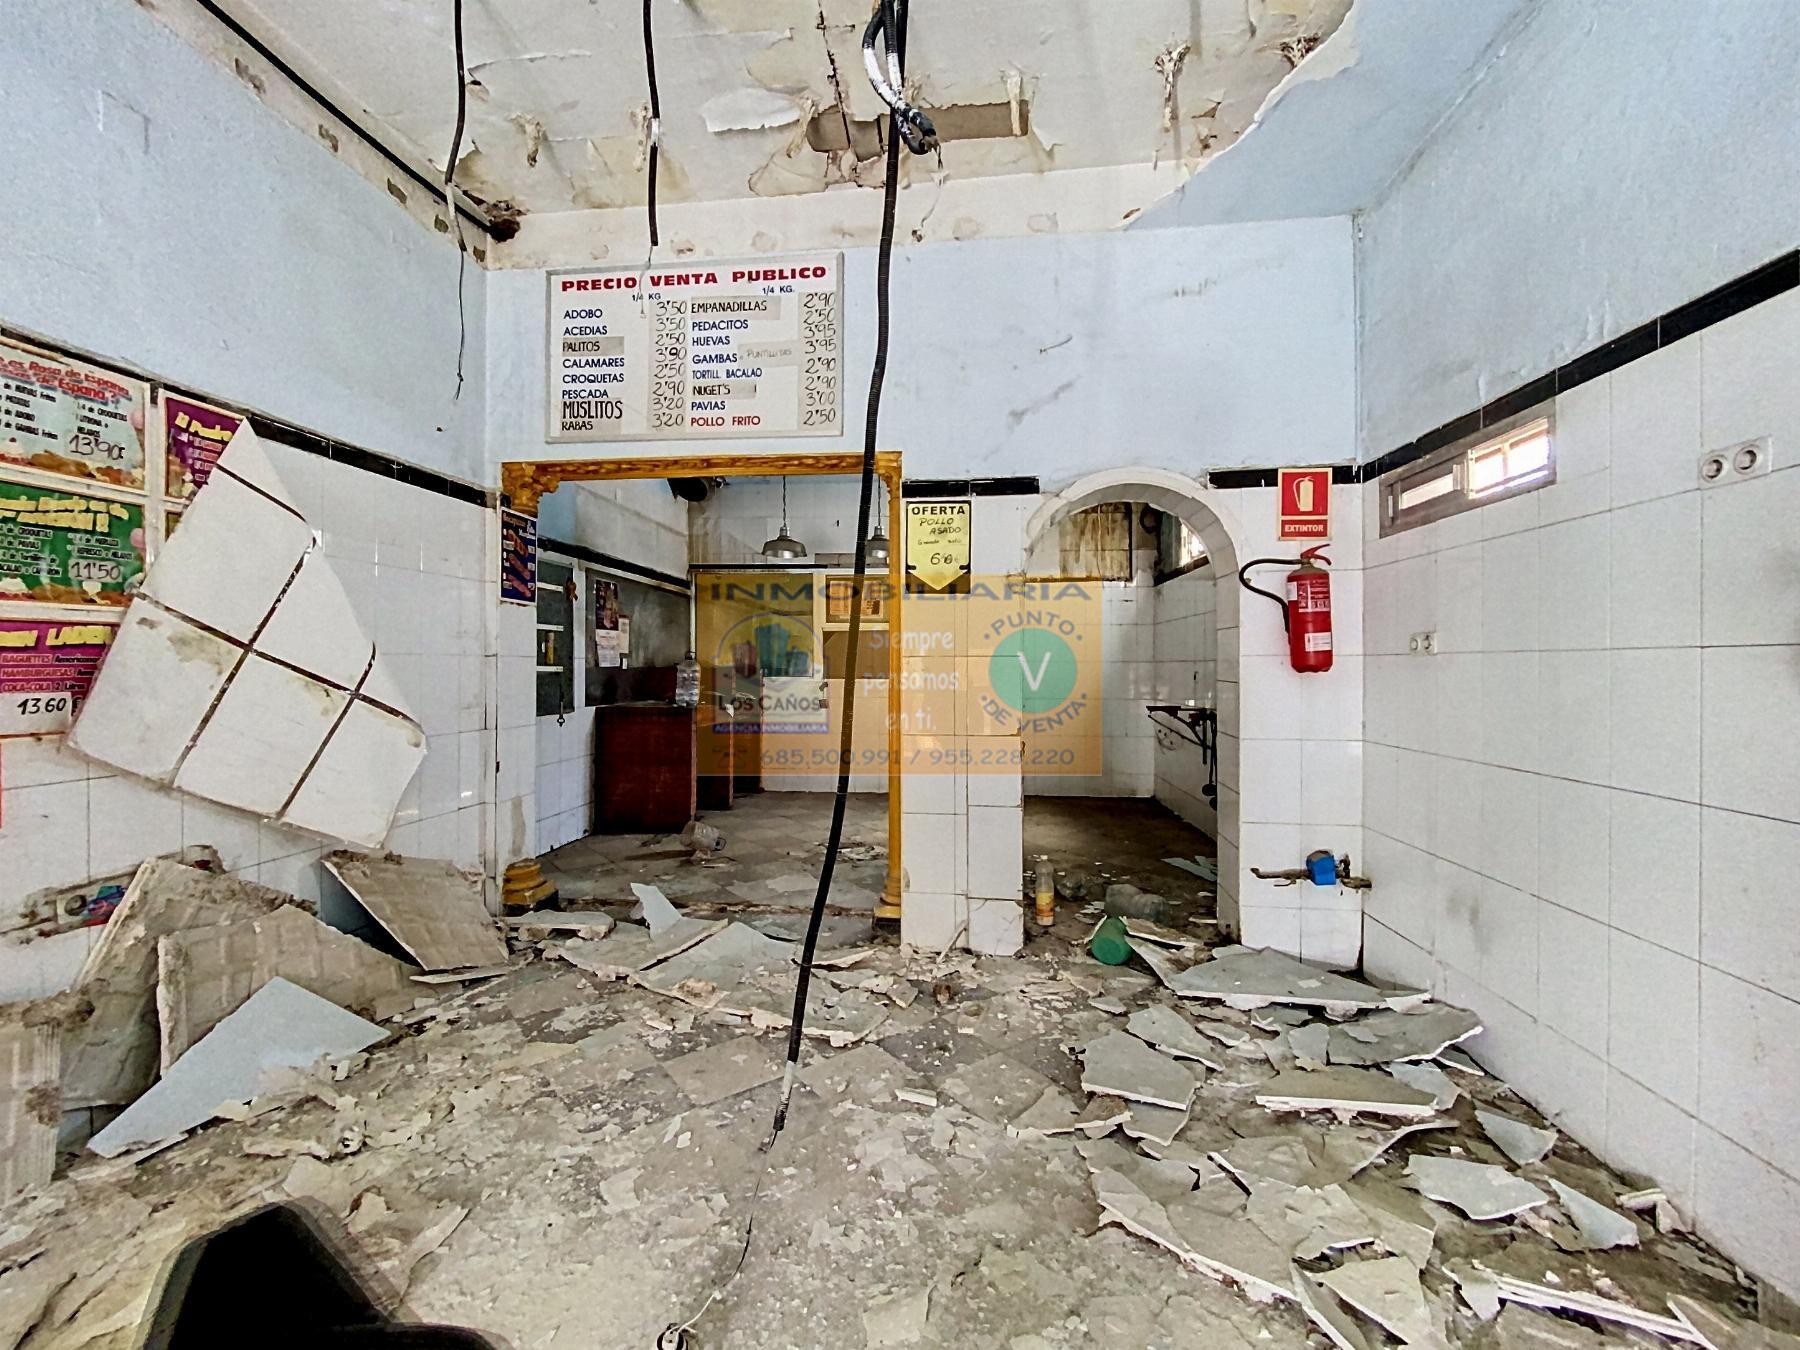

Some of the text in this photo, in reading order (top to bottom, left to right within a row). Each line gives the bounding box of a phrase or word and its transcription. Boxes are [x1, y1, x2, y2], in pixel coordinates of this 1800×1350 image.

[561, 266, 827, 292] PRECIO VENTA PUBLICO
[762, 285, 775, 296] 1/4
[632, 292, 644, 302] 1/4
[803, 292, 836, 309] 2'90
[655, 300, 688, 317] 3'50
[690, 300, 768, 314] EMPANADILLAS
[563, 308, 603, 320] ADOBO
[803, 308, 836, 325] 2'50
[563, 325, 608, 336] ACEDIAS
[655, 317, 686, 332] 3'50
[692, 319, 749, 331] PEDACITOS
[803, 323, 836, 339] 3'95
[655, 332, 686, 346] 2'50
[691, 335, 731, 347] HUEVAS
[562, 341, 601, 352] PALITOS
[804, 338, 837, 355] 3'95
[562, 357, 625, 369] CALAMARES
[692, 353, 738, 365] GAMBAS
[654, 362, 685, 379] 2'50
[804, 357, 837, 374] 2'90
[562, 373, 625, 384] CROQUETAS
[725, 367, 763, 379] BACALAO
[652, 380, 685, 397] 2'90
[692, 382, 731, 396] NUGET'S
[804, 375, 837, 391] 2'90
[562, 388, 609, 400] PESCADA
[805, 390, 836, 407] 3'00
[652, 396, 684, 411] 3'20
[691, 400, 726, 411] PAVIAS
[562, 400, 624, 420] MUSLITOS
[651, 412, 684, 428] 3'20
[690, 415, 761, 427] POLLO FRITO
[803, 407, 836, 426] 2'50
[561, 420, 594, 431] RABAS
[911, 505, 966, 515] OFERTA
[919, 517, 954, 527] POLLO
[930, 526, 962, 535] ASADO
[1284, 524, 1324, 533] EXTINTOR
[71, 561, 121, 580] 11'50
[2, 654, 51, 664] BAGUETTES
[2, 668, 74, 678] HAMBURGUESAS
[3, 682, 51, 692] COCA-COLA
[55, 682, 61, 690] 2
